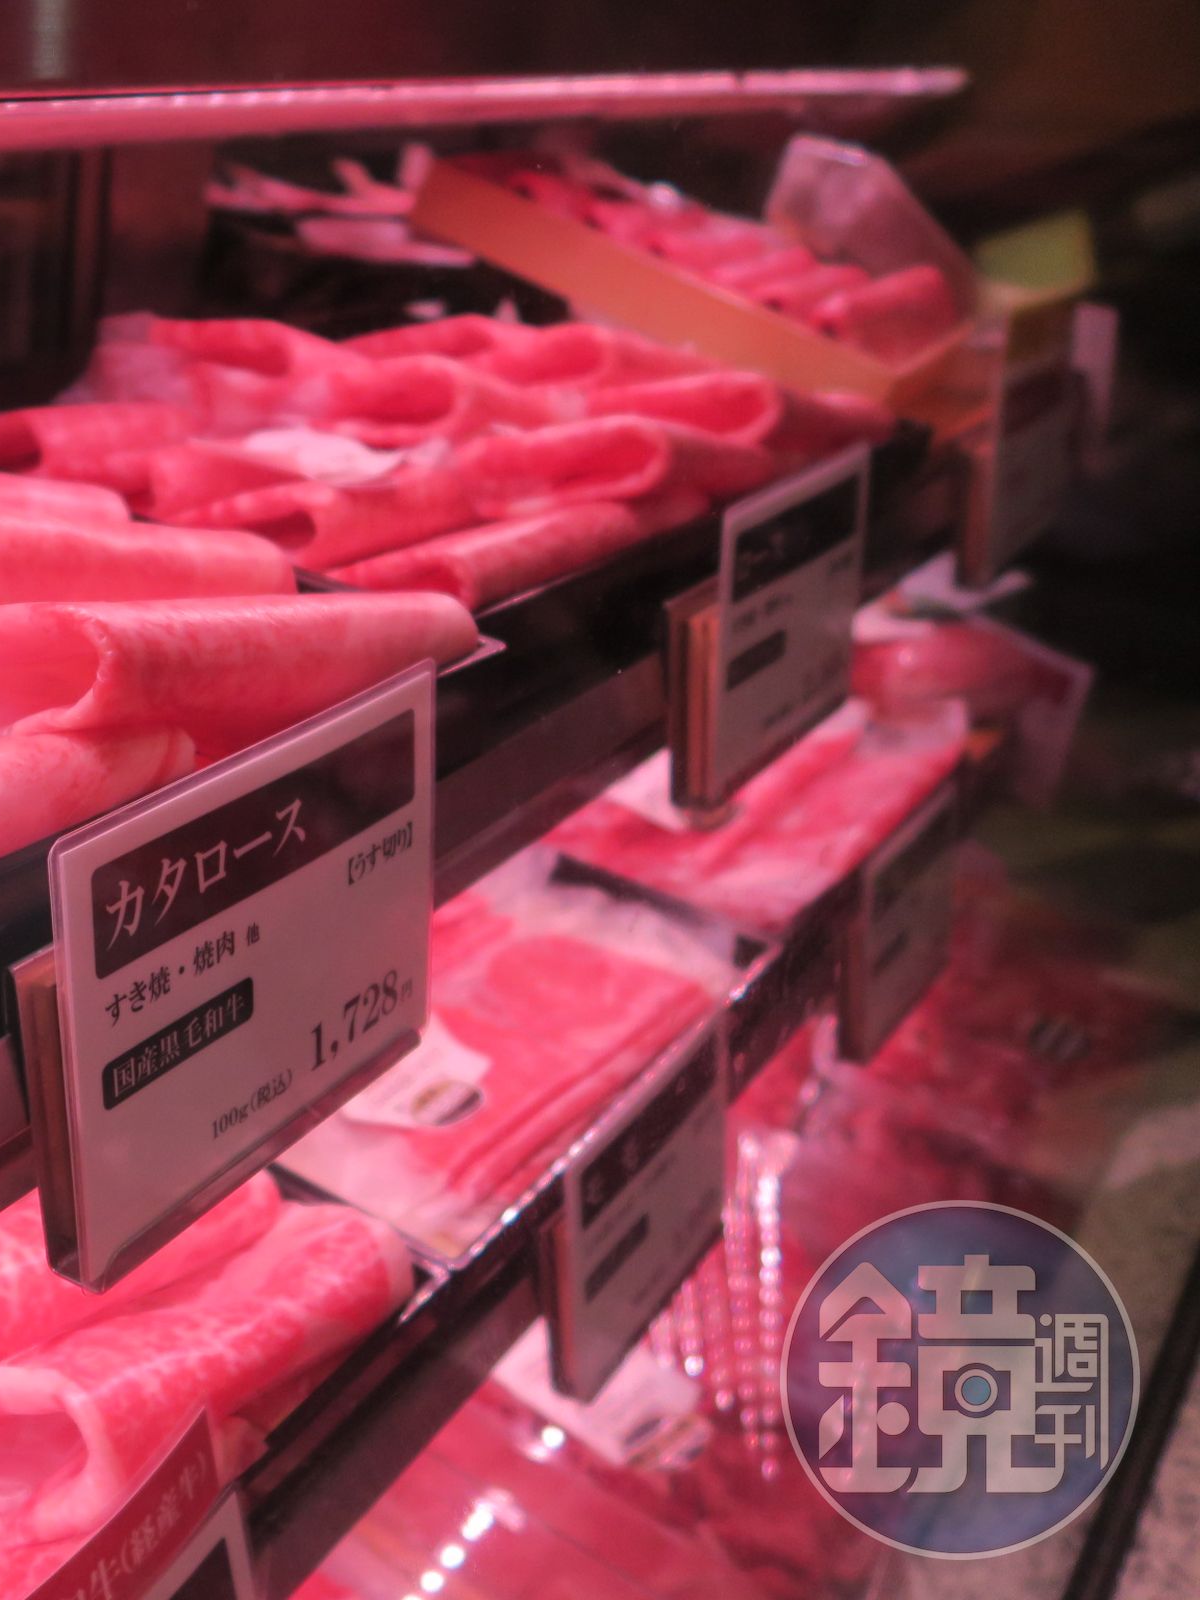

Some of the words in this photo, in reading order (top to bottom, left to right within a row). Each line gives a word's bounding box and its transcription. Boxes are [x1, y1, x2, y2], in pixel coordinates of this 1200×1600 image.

[106, 798, 306, 951] カタロース
[105, 930, 235, 1027] すき焼・焼肉
[245, 922, 261, 946] 他
[112, 993, 245, 1097] 国産黒毛和牛
